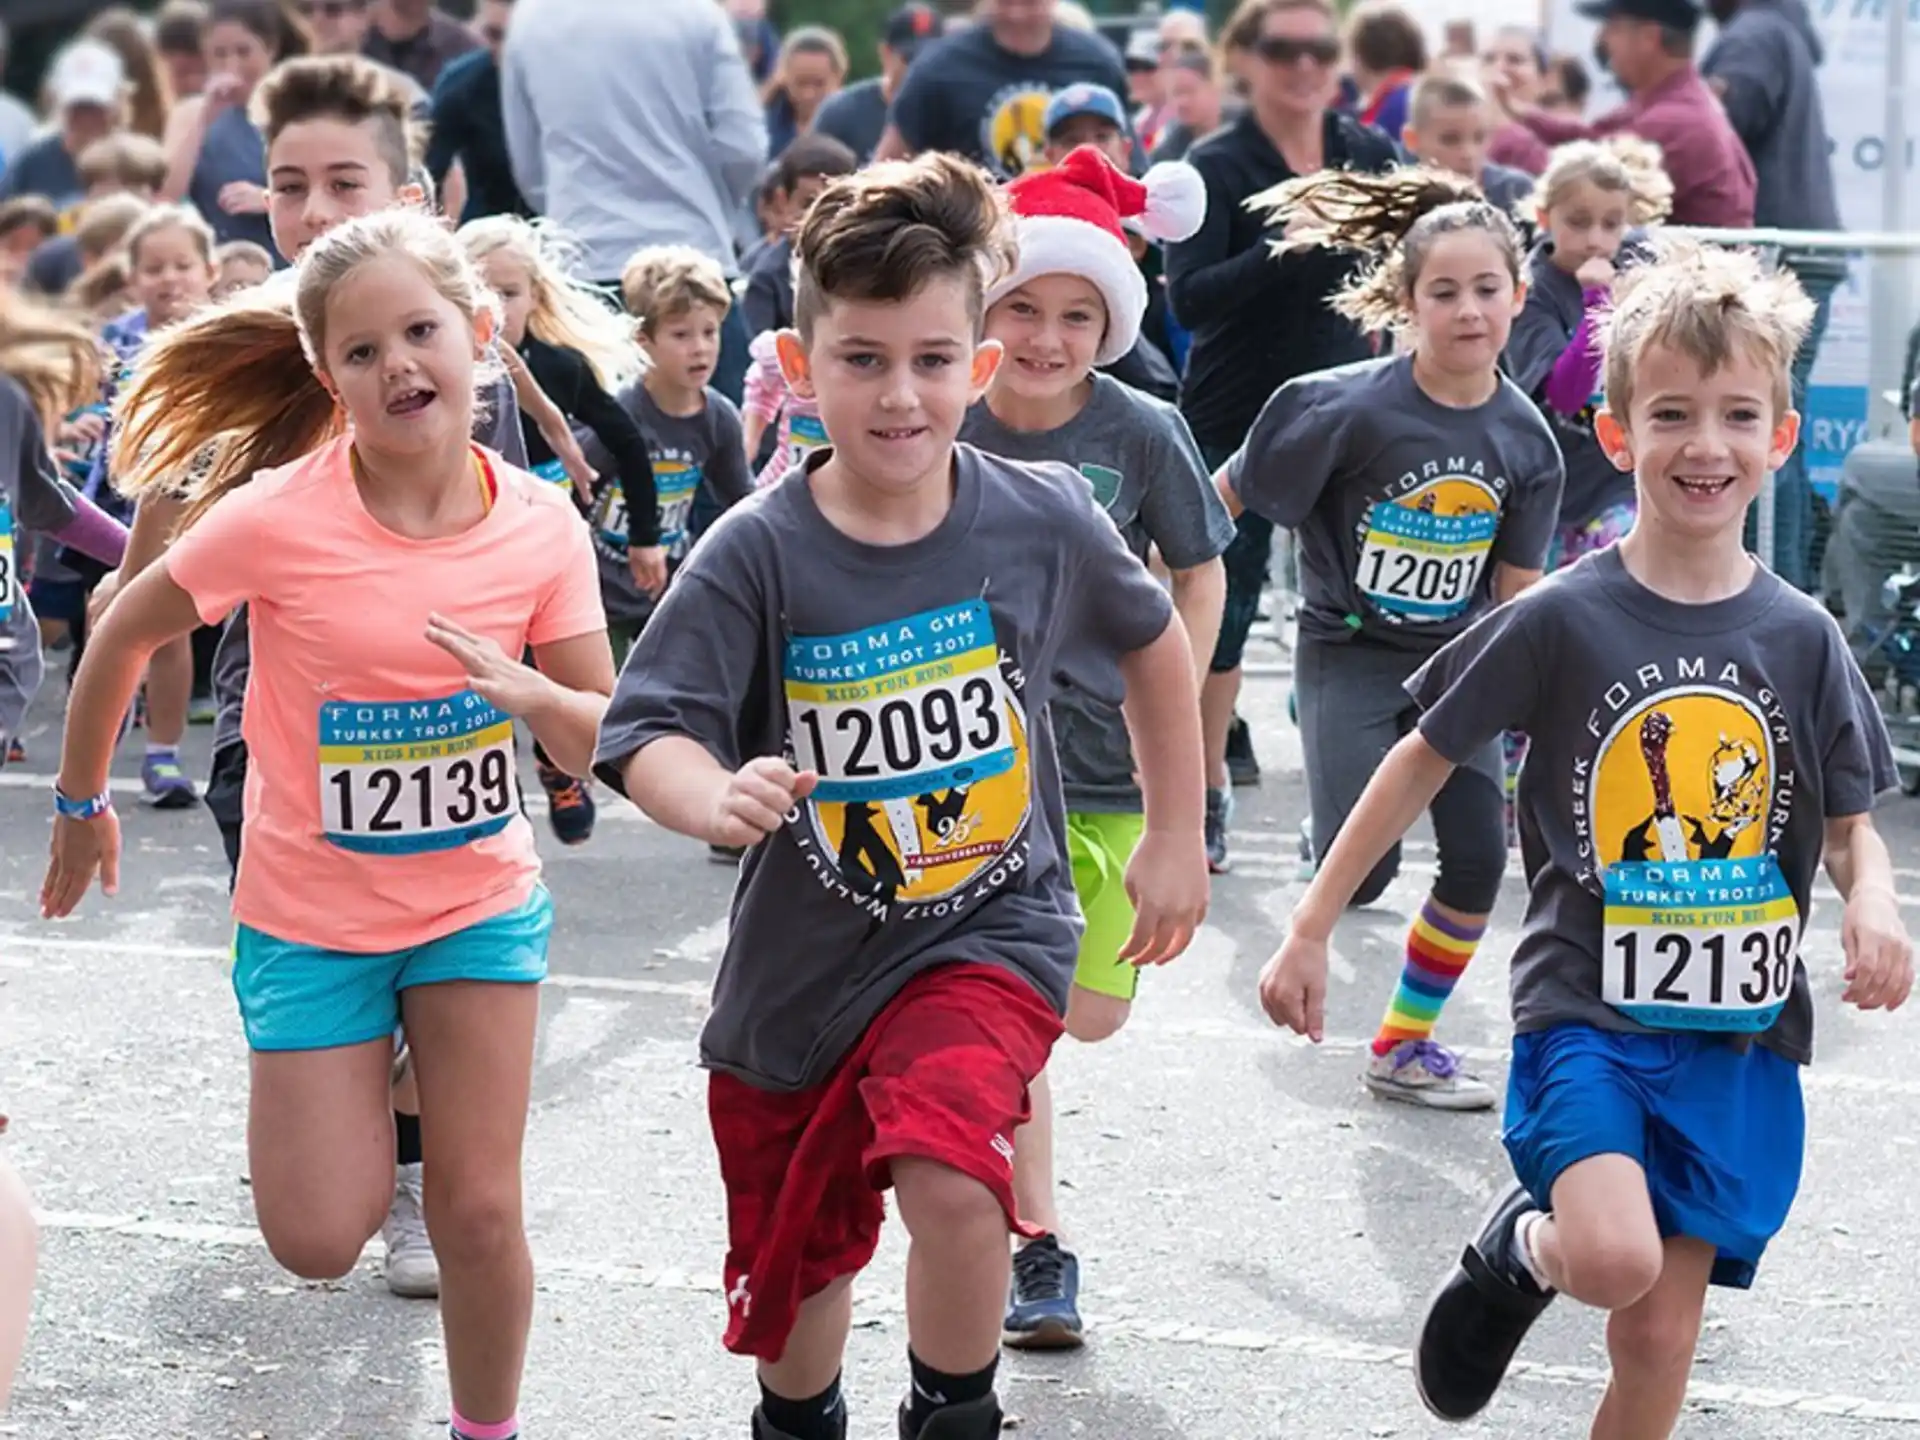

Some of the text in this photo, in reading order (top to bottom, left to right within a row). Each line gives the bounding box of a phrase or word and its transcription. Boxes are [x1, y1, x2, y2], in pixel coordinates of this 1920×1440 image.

[1382, 456, 1485, 497] FORMA
[1369, 549, 1478, 600] 12091
[789, 609, 974, 659] FORMA GYM
[794, 632, 976, 680] TURKEY TROT 2017
[998, 648, 1026, 691] YM
[826, 685, 869, 701] KIDS
[875, 677, 911, 694] FUN
[332, 703, 453, 722] FORMA
[333, 708, 497, 742] TURKEY TROT 2017
[800, 678, 999, 777] 12093
[362, 747, 403, 762] KIDS
[408, 744, 441, 759] FUN
[1572, 657, 1795, 858] CREEK FORMA GYM TURK
[330, 749, 509, 831] 12139
[796, 837, 888, 923] WALNUT
[1618, 864, 1748, 883] FORMA
[1620, 889, 1697, 903] TURKEY
[1707, 886, 1754, 902] TROT
[903, 894, 966, 920] 2017
[1651, 911, 1695, 925] KIDS
[1702, 911, 1735, 926] FUN
[1614, 925, 1792, 1004] 12138
